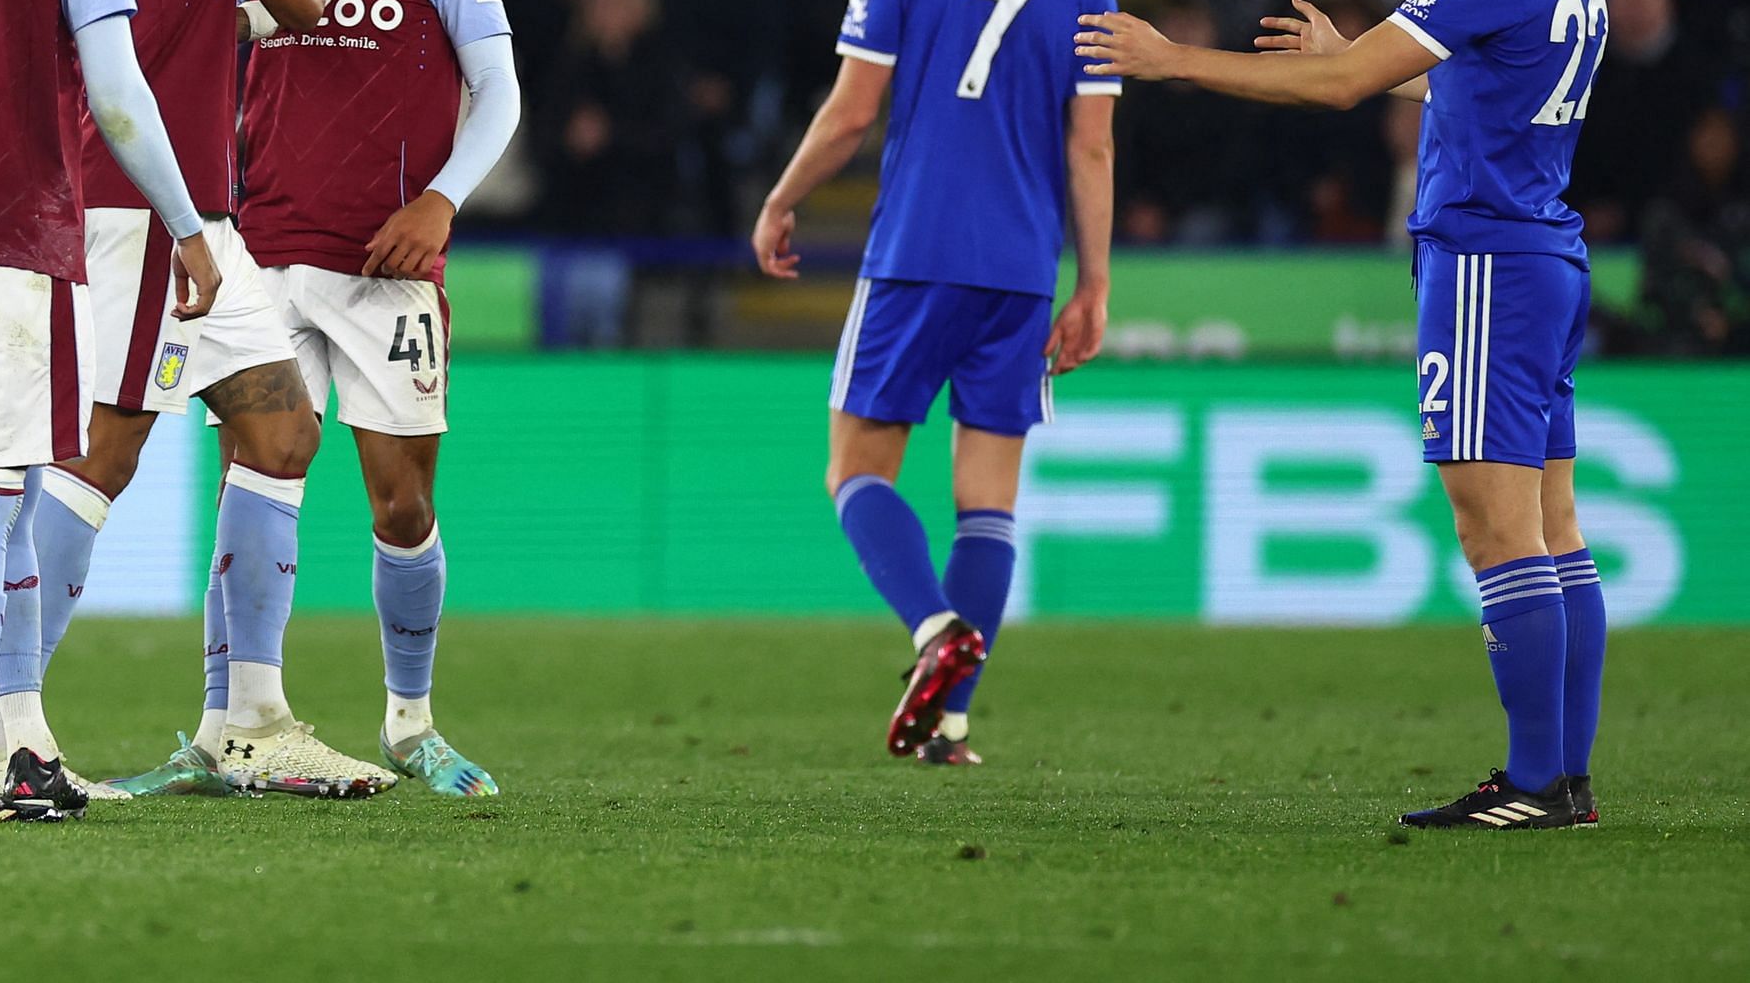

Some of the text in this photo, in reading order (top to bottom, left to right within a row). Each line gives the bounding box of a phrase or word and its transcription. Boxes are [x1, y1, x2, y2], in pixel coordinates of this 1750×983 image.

[301, 34, 337, 47] Drive.
[338, 36, 380, 50] Smile.
[164, 345, 187, 357] AVFC
[387, 312, 436, 372] 41
[1012, 402, 1686, 626] FBS
